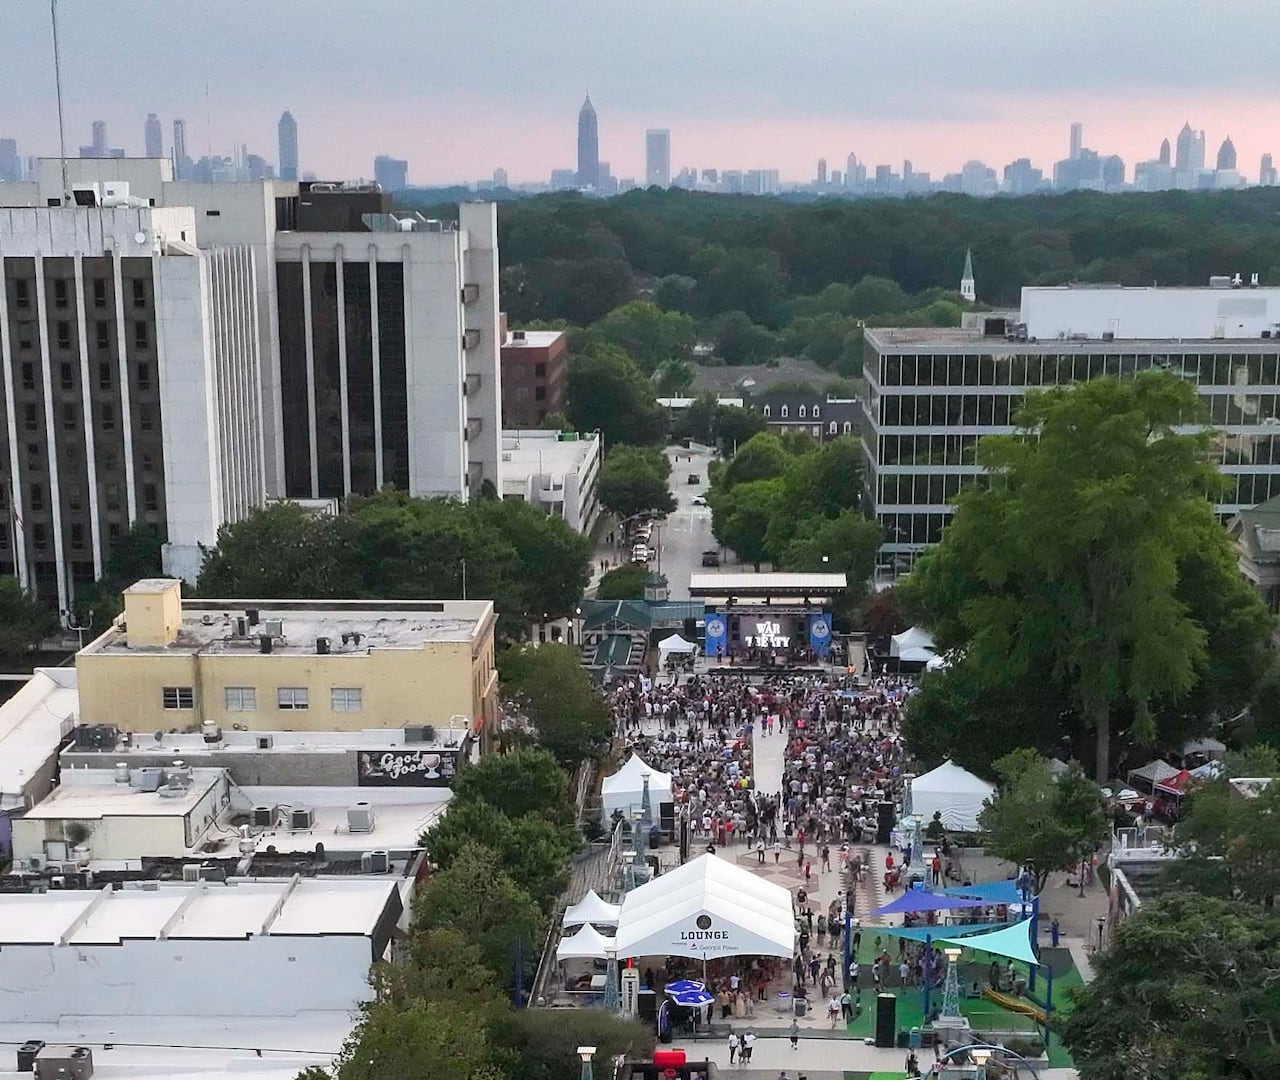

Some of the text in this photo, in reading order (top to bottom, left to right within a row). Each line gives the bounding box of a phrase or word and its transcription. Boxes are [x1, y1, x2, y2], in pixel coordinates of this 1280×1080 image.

[756, 622, 781, 634] WAR
[380, 751, 420, 771] Good
[681, 931, 729, 940] LOUNGE
